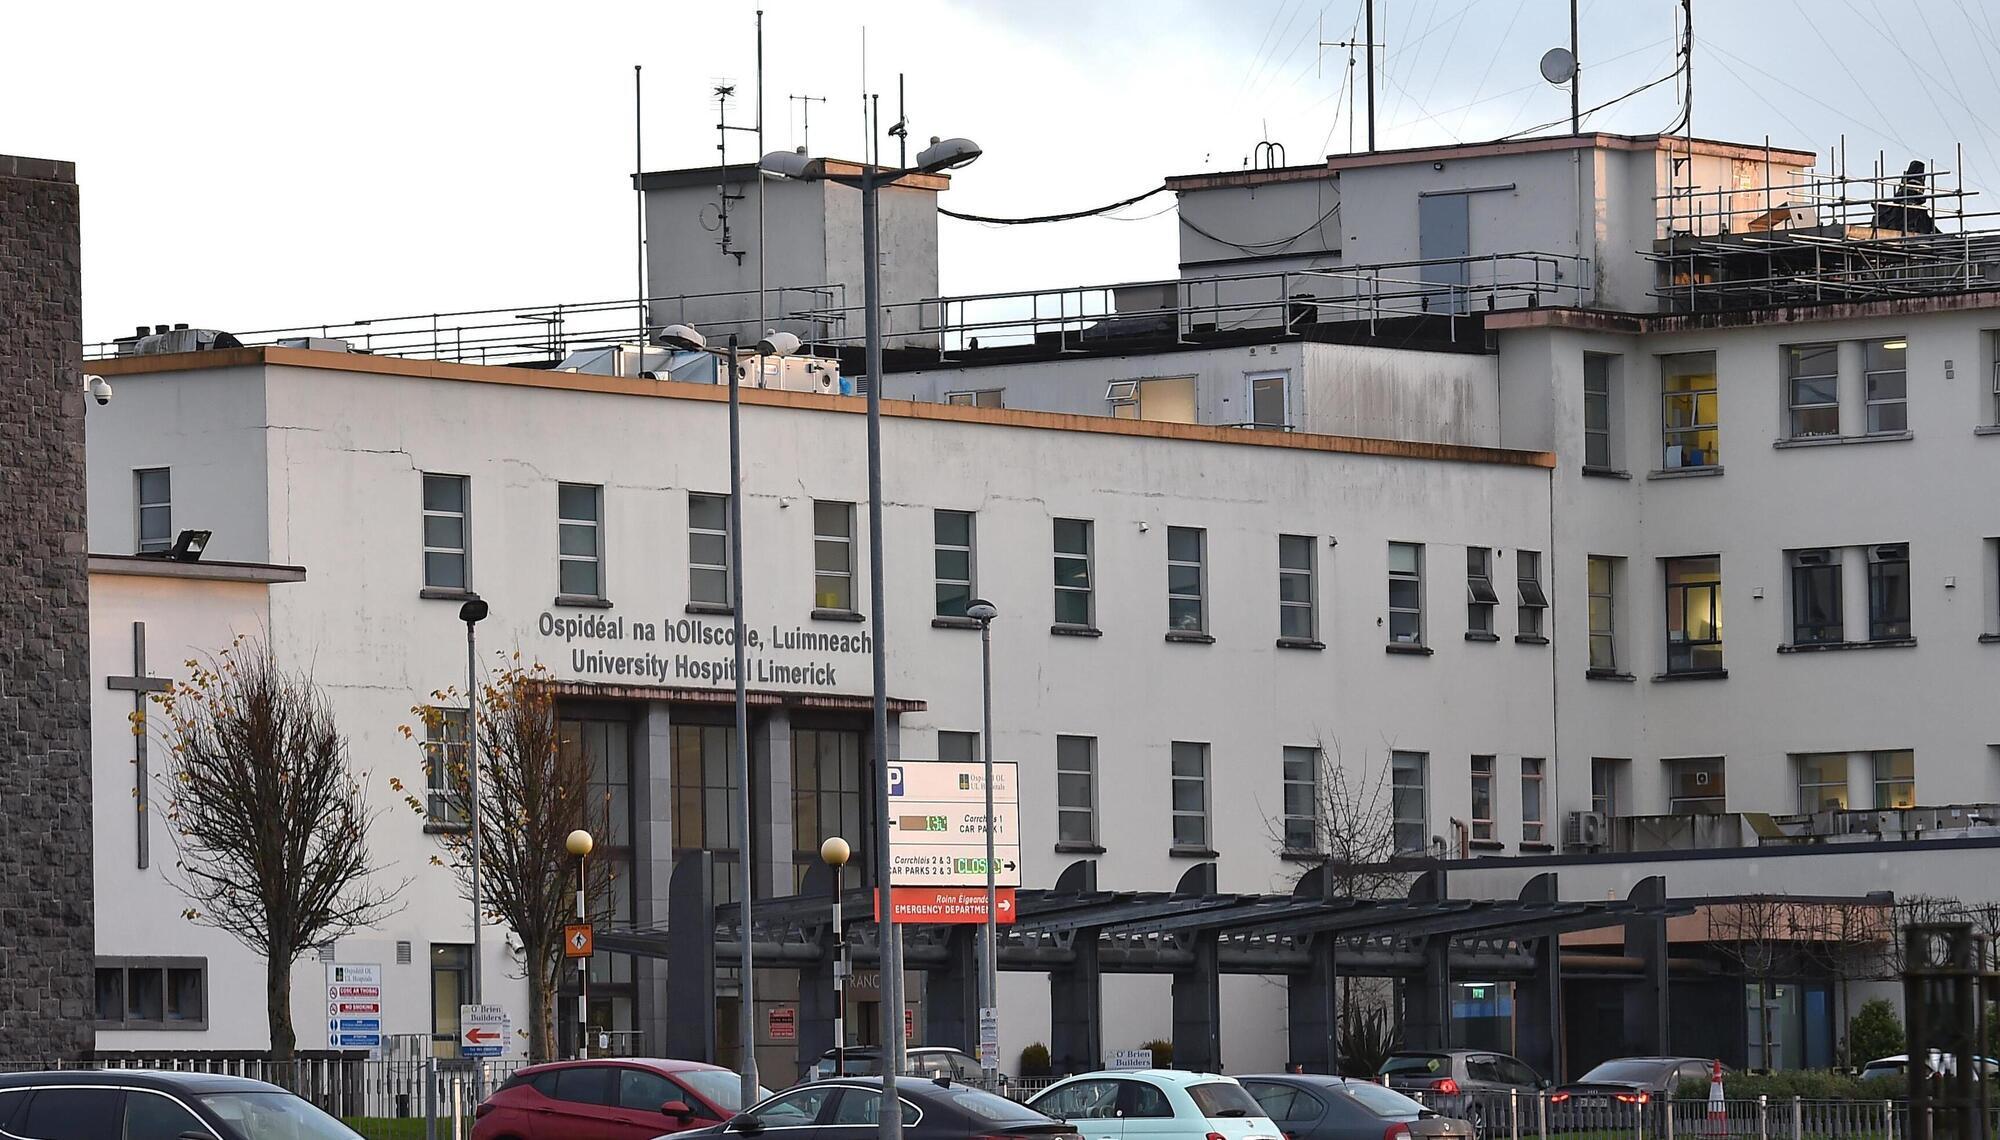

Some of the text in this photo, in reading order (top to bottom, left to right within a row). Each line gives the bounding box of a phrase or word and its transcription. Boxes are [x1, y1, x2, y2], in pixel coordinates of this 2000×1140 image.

[538, 612, 872, 654] Ospidéal na hOllscole, Luimneach
[572, 649, 837, 686] University Hospitl Limerick
[959, 824, 1003, 834] CAR PAK 1
[931, 856, 937, 865] 2
[939, 856, 944, 865] &
[946, 856, 951, 865] 3
[905, 866, 930, 875] PARKS
[932, 866, 937, 875] 2
[939, 866, 945, 875] &
[947, 866, 952, 875] 3
[895, 905, 989, 915] EMERGENCY DEPARTME
[1127, 1050, 1151, 1058] Brien
[1116, 1059, 1151, 1067] Builders
